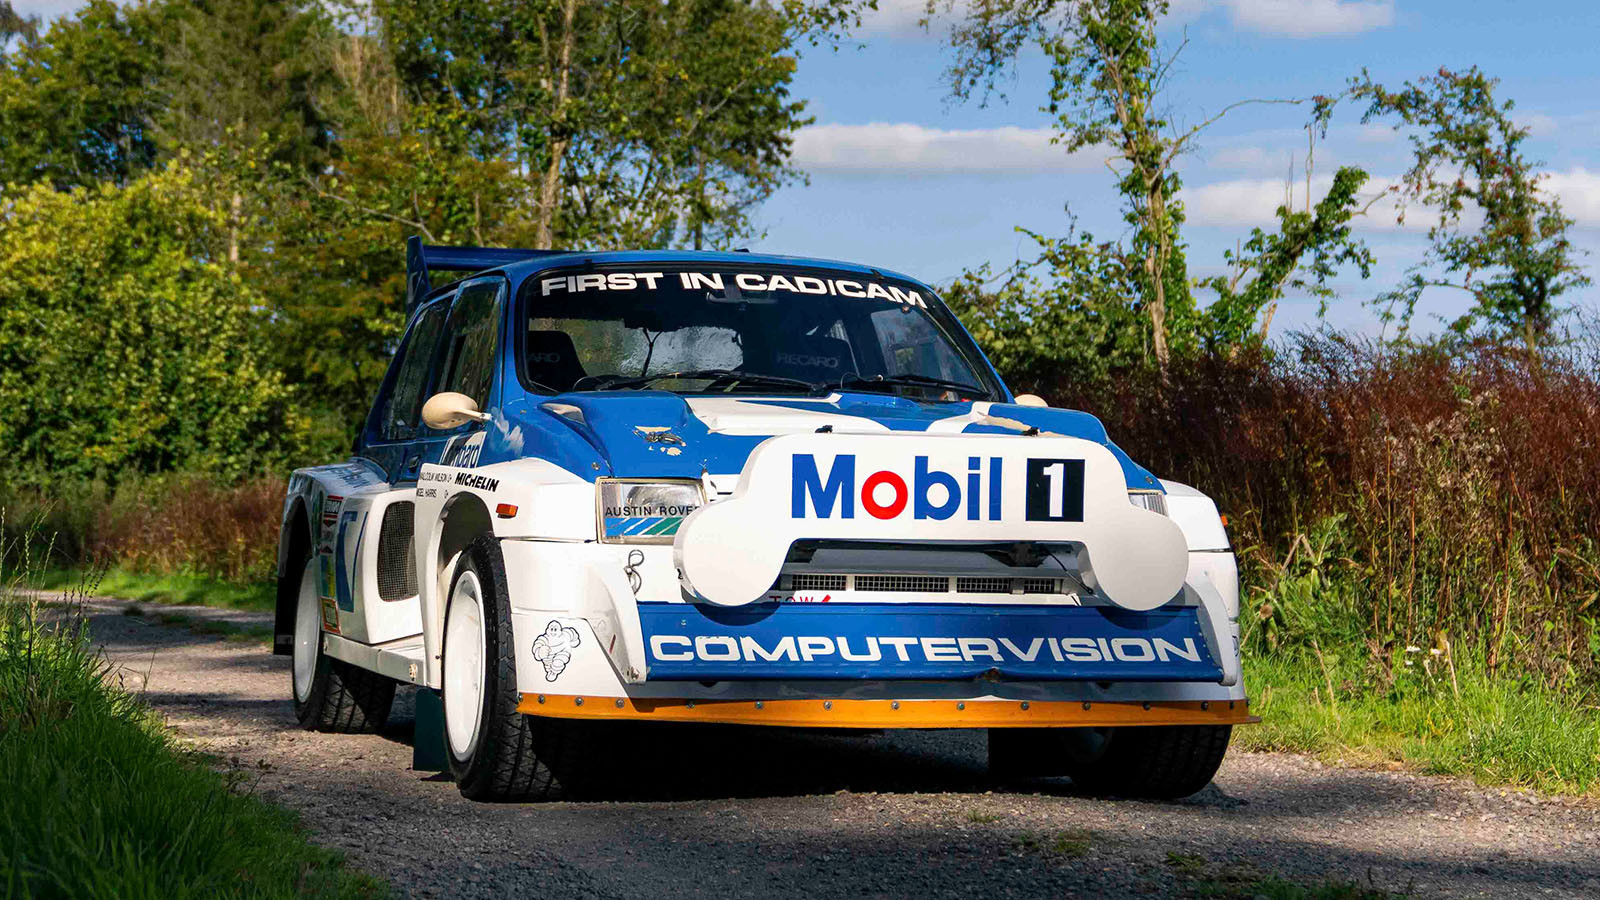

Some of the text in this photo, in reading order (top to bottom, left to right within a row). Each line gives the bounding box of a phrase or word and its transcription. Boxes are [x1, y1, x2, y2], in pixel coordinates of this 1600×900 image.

[542, 272, 664, 296] FIRST
[680, 272, 725, 290] IN
[776, 352, 839, 368] RECARO
[454, 472, 500, 492] MICHELIN
[792, 454, 1065, 520] Mobil 1
[605, 506, 652, 517] AUSTIN
[650, 635, 1202, 663] COMPUTERVISION
